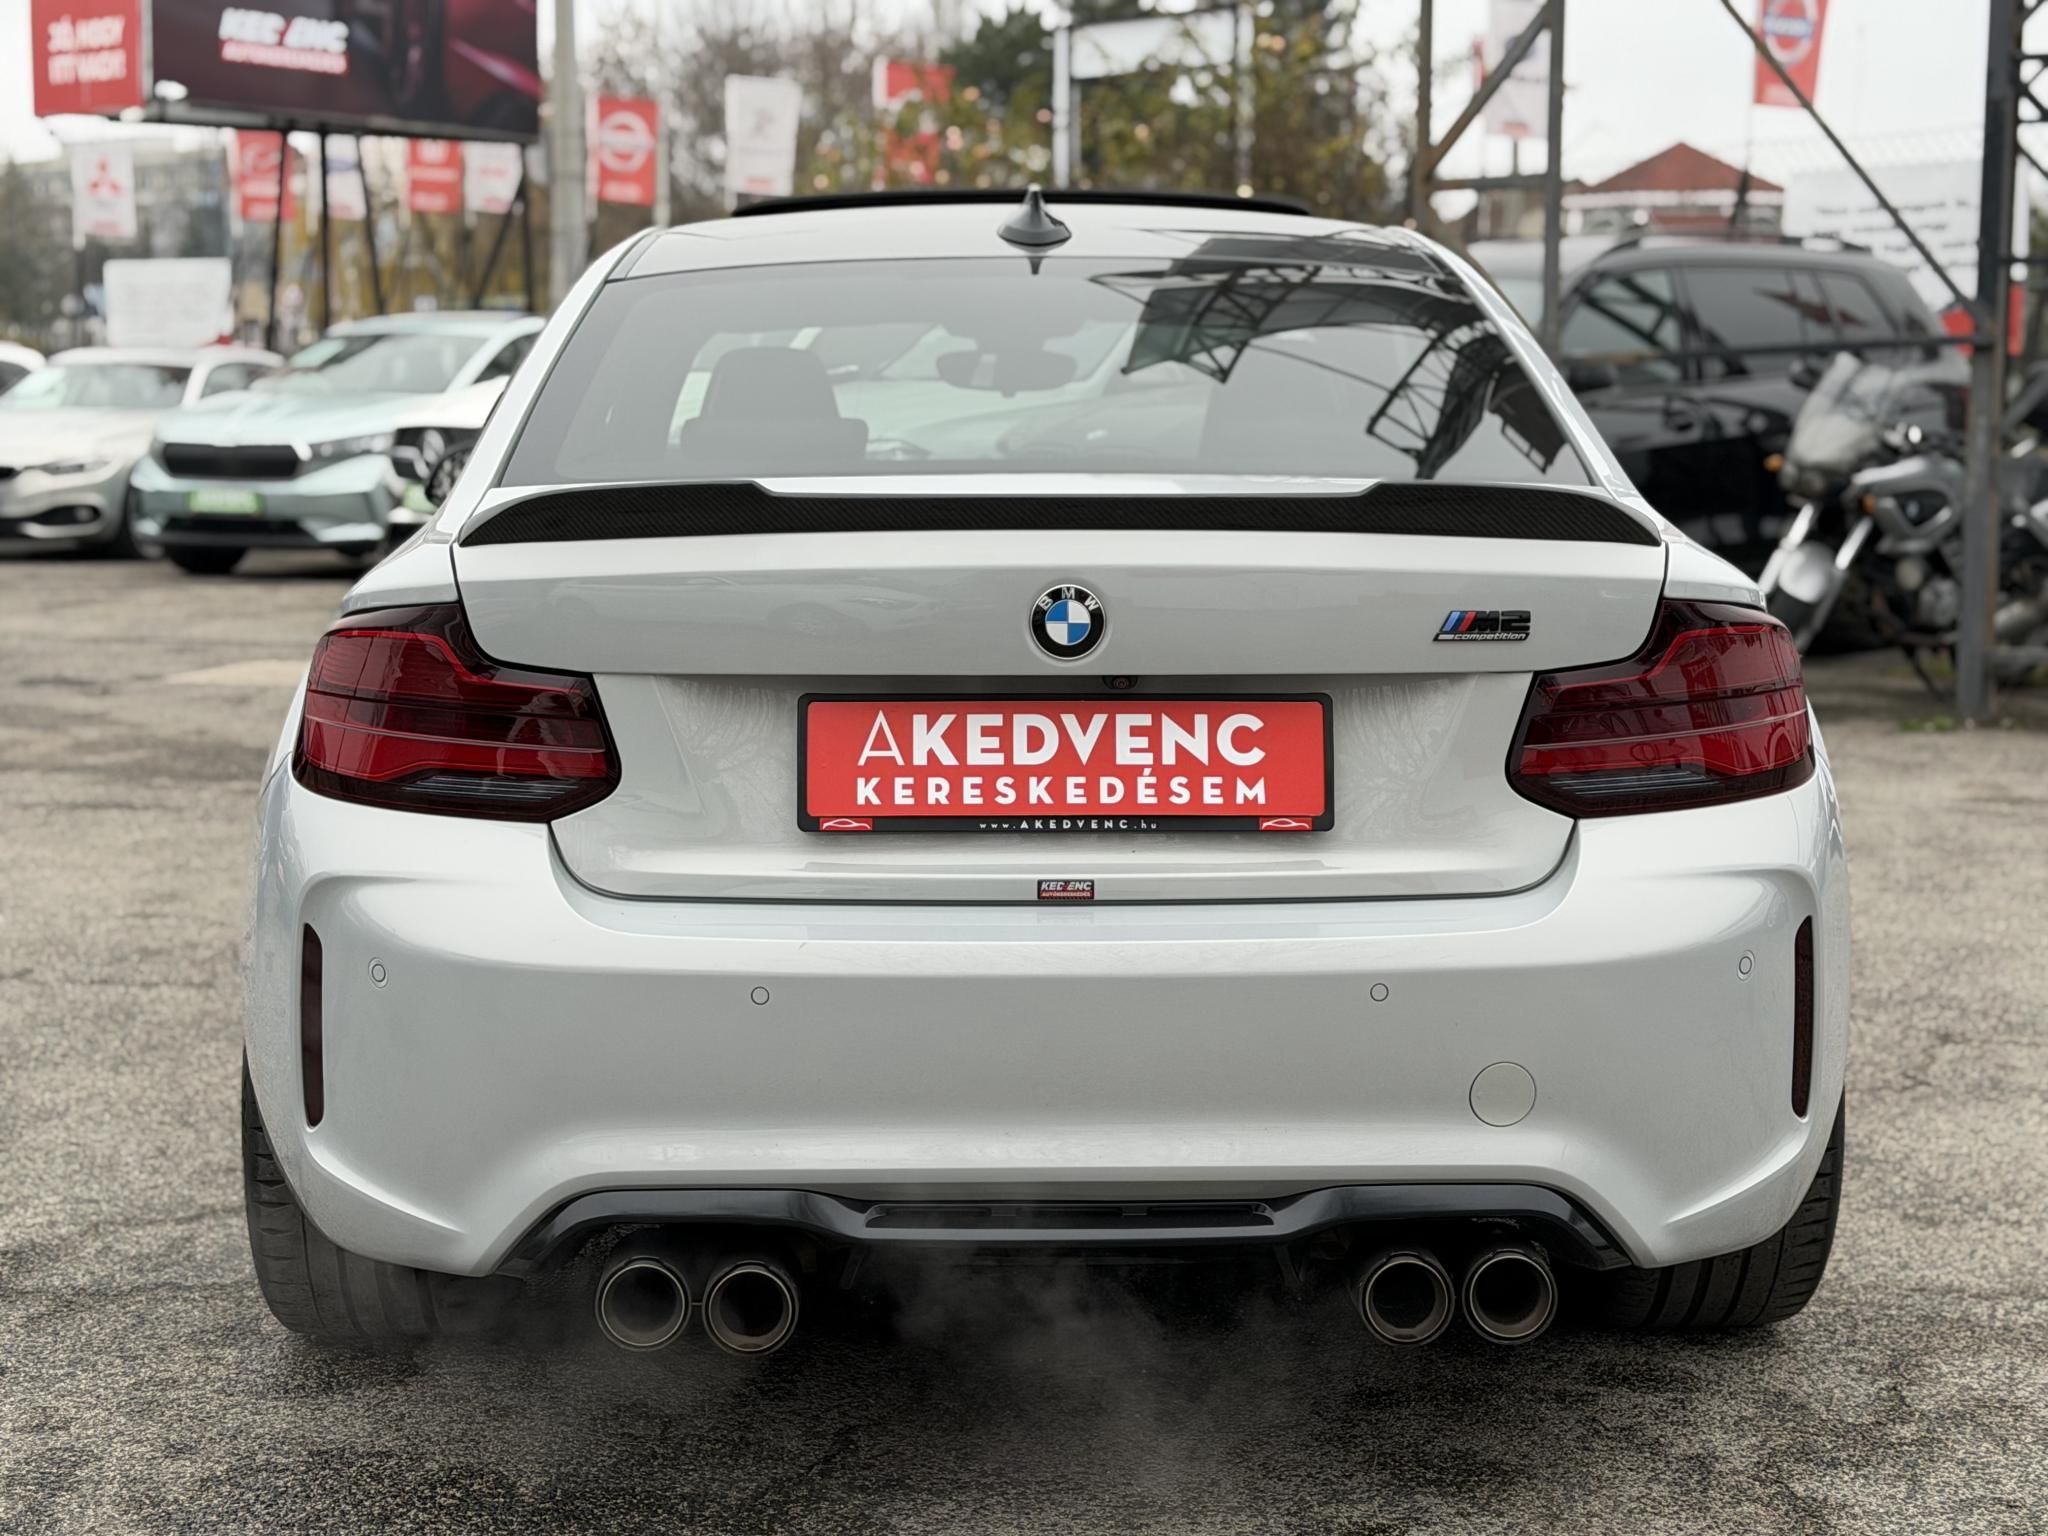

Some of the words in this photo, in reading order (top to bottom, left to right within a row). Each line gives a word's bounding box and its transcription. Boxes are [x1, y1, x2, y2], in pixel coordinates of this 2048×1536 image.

[1038, 586, 1100, 612] BMW
[1469, 610, 1531, 632] M2
[1454, 632, 1527, 641] competition
[856, 768, 1267, 805] KERESKEDÉSEM
[979, 819, 1157, 829] www.AKEDVENC.hu
